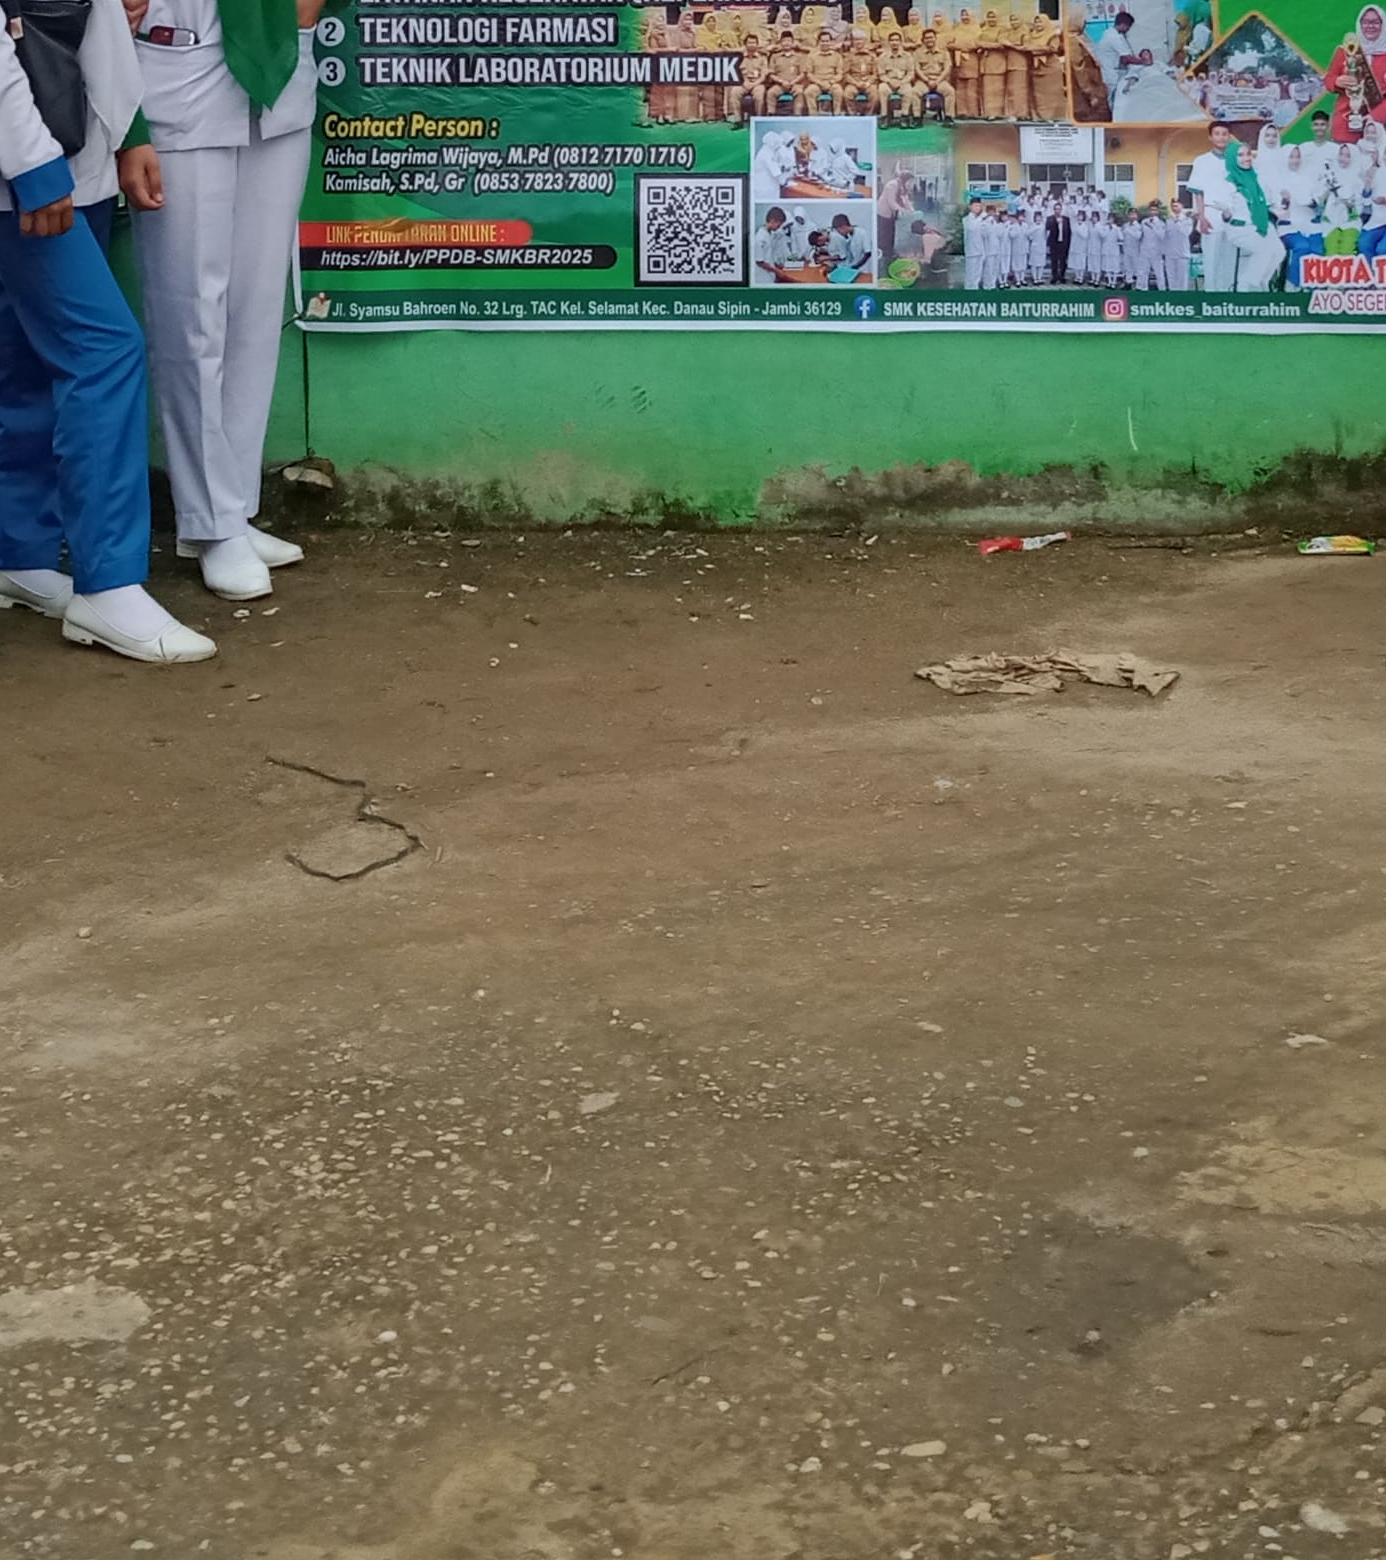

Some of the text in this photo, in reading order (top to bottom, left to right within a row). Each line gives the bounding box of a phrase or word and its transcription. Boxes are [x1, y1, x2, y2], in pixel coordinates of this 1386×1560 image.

[324, 16, 614, 43] 2 TEKNOLOGI FARMASI
[326, 56, 740, 83] 3 TEKNIK LABORATORIUM MEDIK
[324, 115, 405, 137] Contact
[410, 116, 483, 137] Person
[324, 146, 695, 169] Aicha Lagrima Wijaya, M.Pd (0812 7170 1716)
[325, 172, 614, 194] Kamisah, S.Pd, Gr (0853 7823 7800)
[326, 226, 351, 244] LINK
[451, 224, 497, 242] ONLINE
[321, 248, 593, 269] https://bit.ly/PPDB-SMKBR2025
[1303, 258, 1370, 284] KUOTA
[332, 302, 346, 317] Jl.
[349, 302, 400, 320] Syamsu
[403, 301, 457, 316] Bahroen
[460, 301, 481, 315] No.
[484, 301, 499, 315] 32
[502, 301, 527, 318] Lrg.
[530, 301, 556, 315] TAC
[560, 301, 585, 315] Kel.
[588, 301, 639, 315] Selamat
[643, 301, 670, 315] Kec.
[674, 301, 714, 315] Danau
[717, 301, 750, 318] Sipin
[762, 301, 800, 316] Jambi
[804, 302, 842, 316] 36129
[883, 302, 1094, 318] SMK KESEHATAN BAITURRAHIM
[1130, 301, 1301, 320] smkkes_baiturrahim
[1312, 293, 1343, 312] AYO
